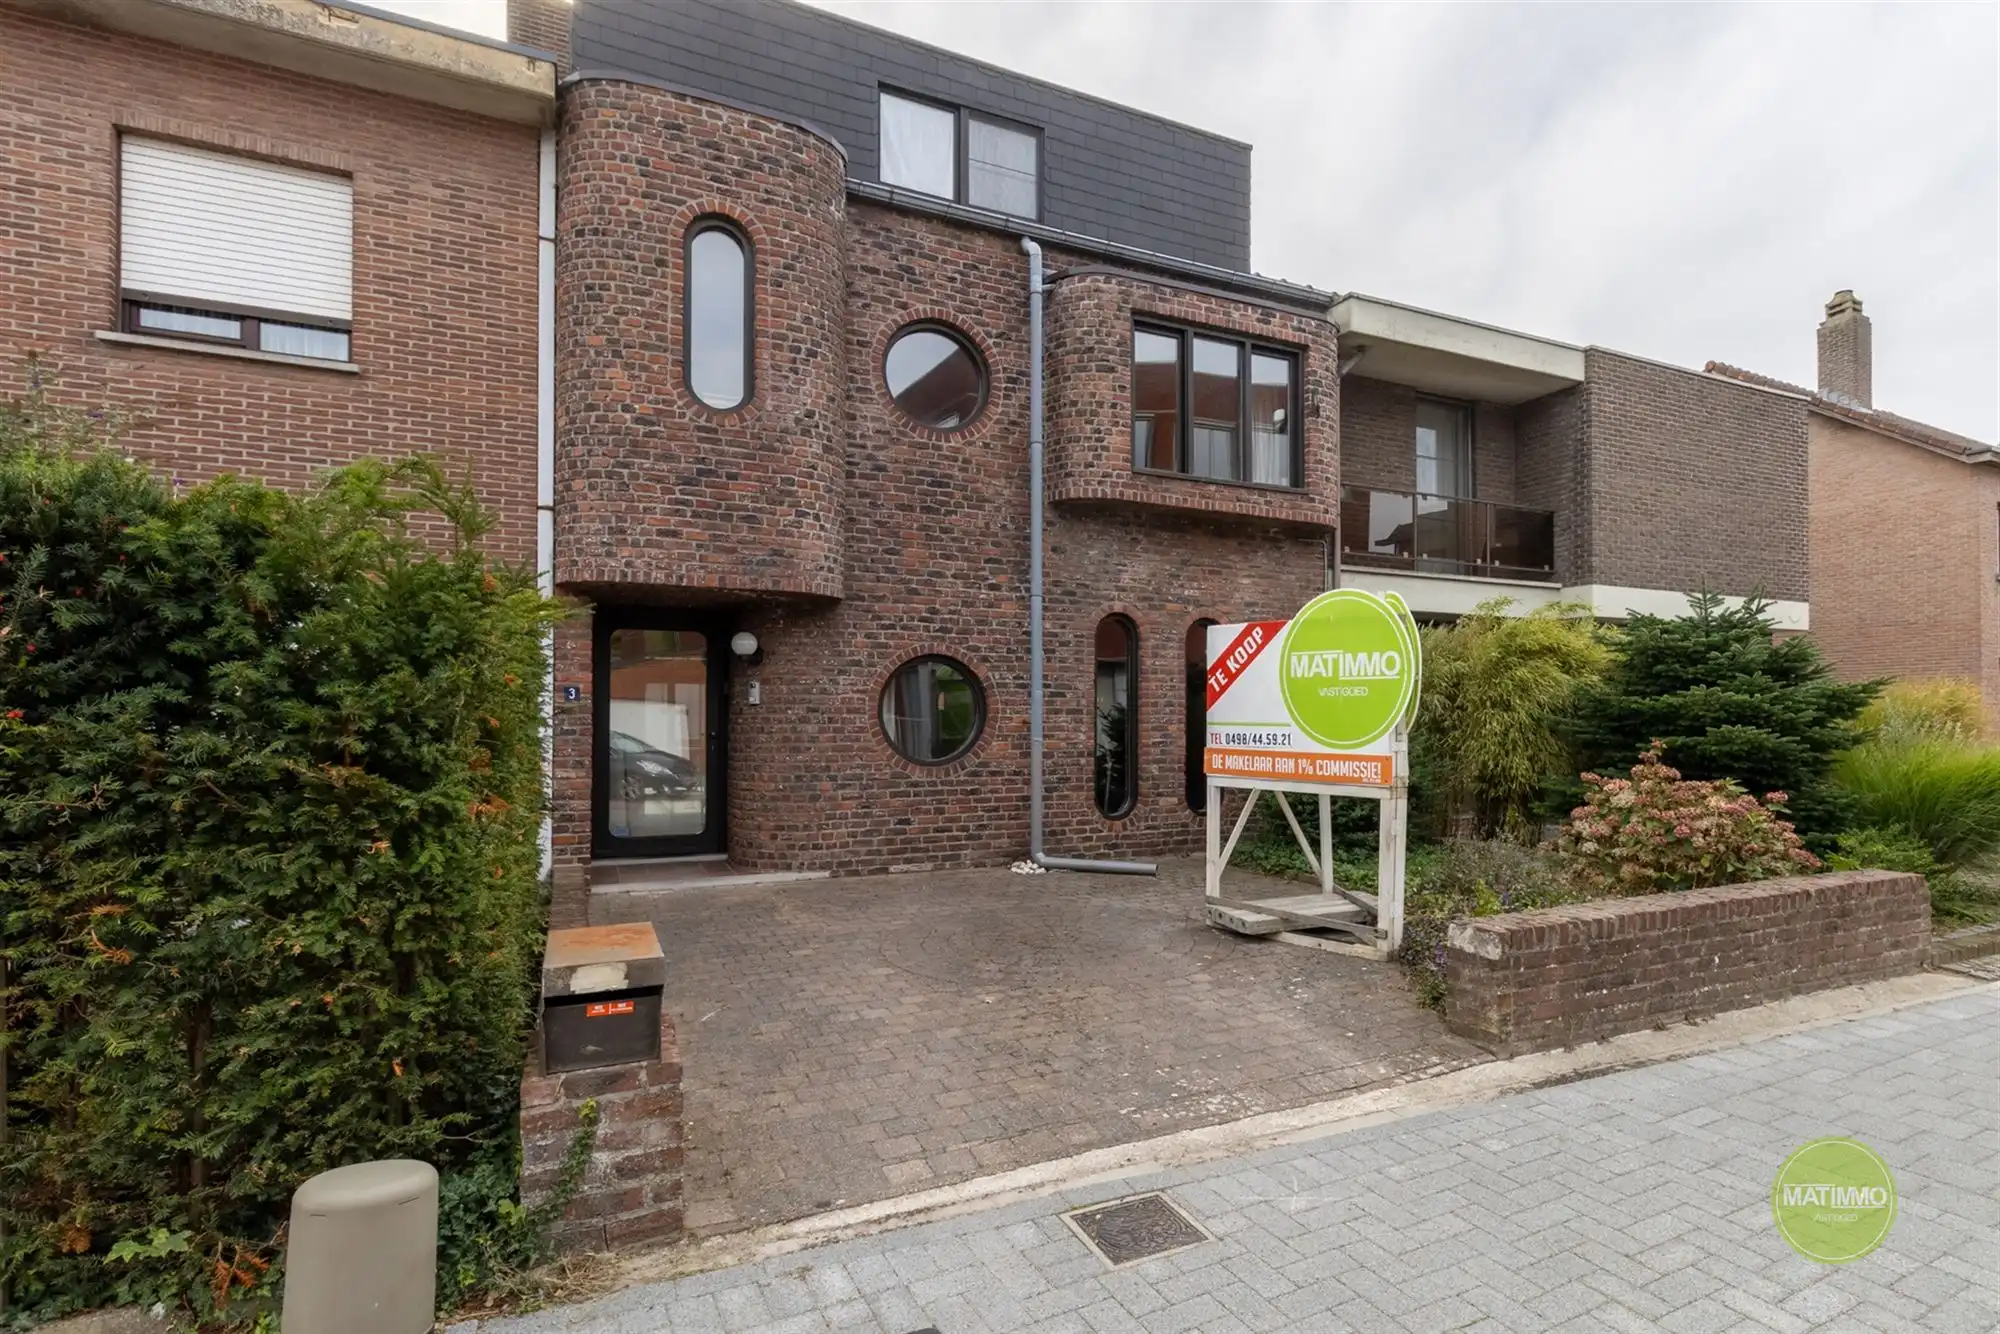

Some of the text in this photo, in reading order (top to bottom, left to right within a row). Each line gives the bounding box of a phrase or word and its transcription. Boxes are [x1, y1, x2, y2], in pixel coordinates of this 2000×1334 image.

[1209, 626, 1263, 692] TE KOOP
[1290, 650, 1401, 680] MATIMMO
[568, 687, 576, 699] 3
[1210, 732, 1292, 746] TEL 0498/44.59.21
[1212, 753, 1382, 779] DE MAKELAAR AAN 1% COMMISSIE!
